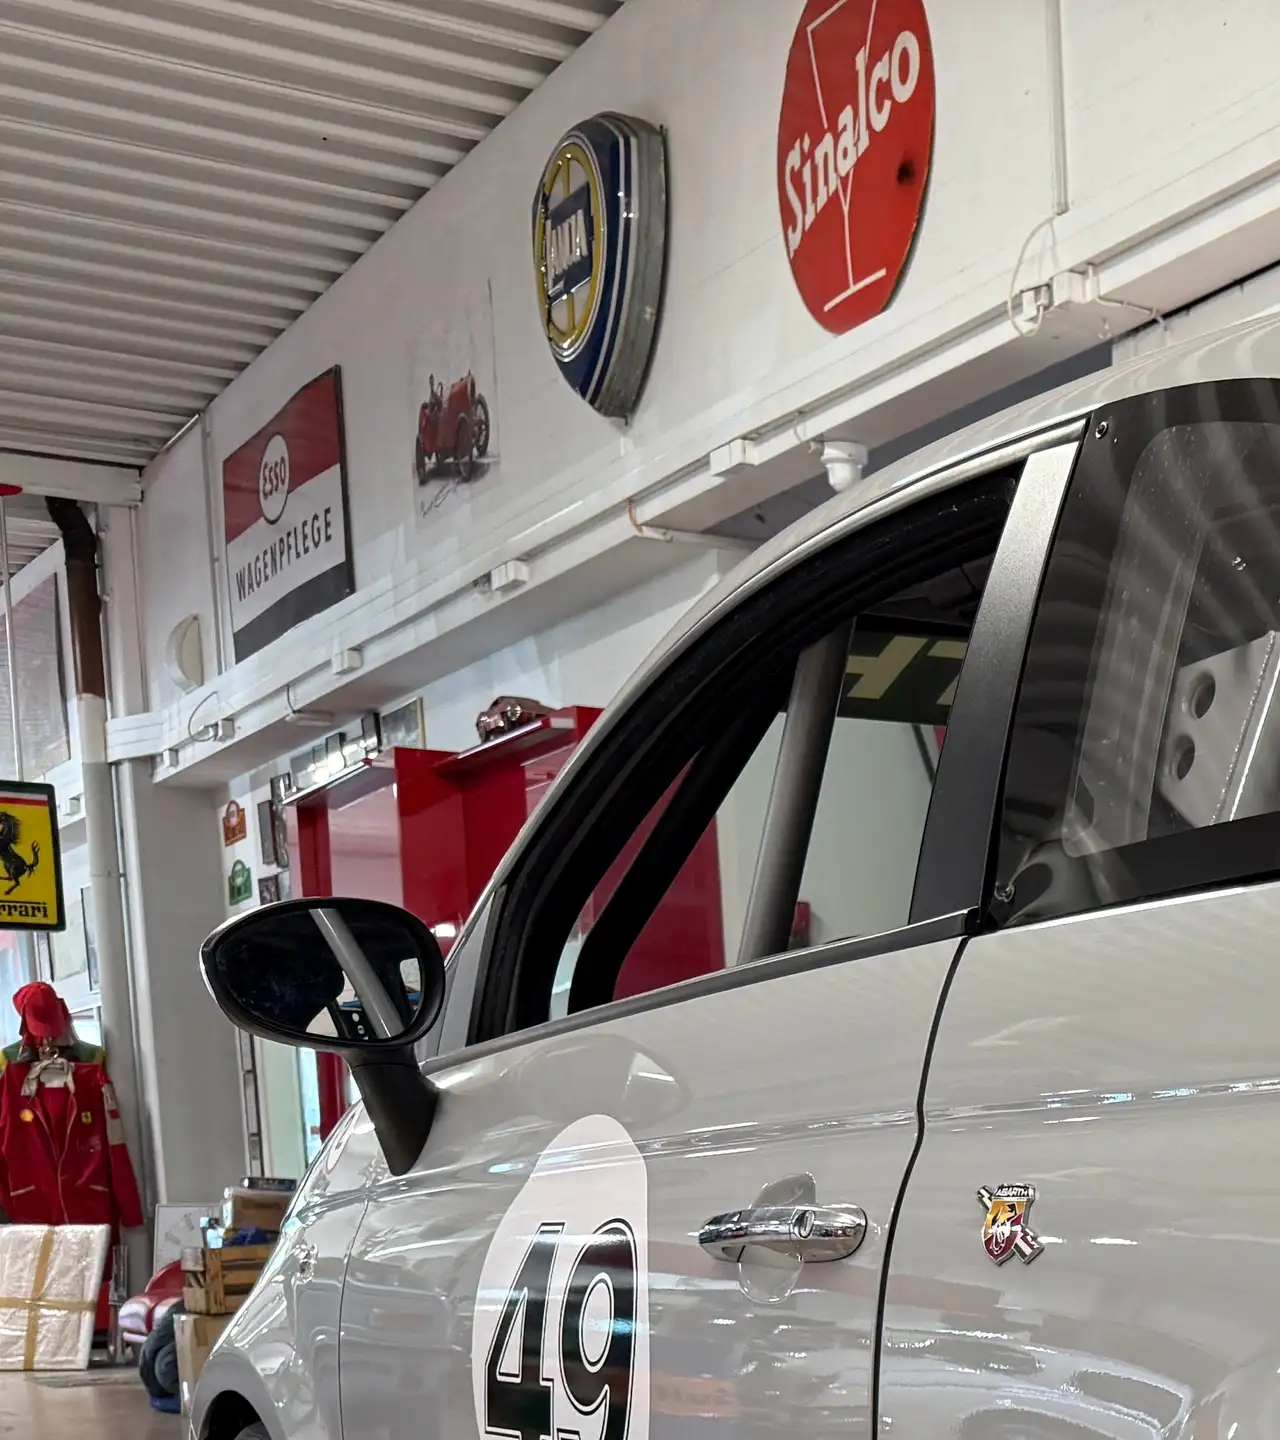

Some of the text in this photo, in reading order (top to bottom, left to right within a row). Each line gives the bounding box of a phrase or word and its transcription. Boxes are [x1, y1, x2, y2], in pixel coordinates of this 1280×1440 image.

[784, 30, 921, 259] Sinalco
[235, 506, 333, 603] WAGENPFLEGE
[995, 1187, 1028, 1198] ABARTH
